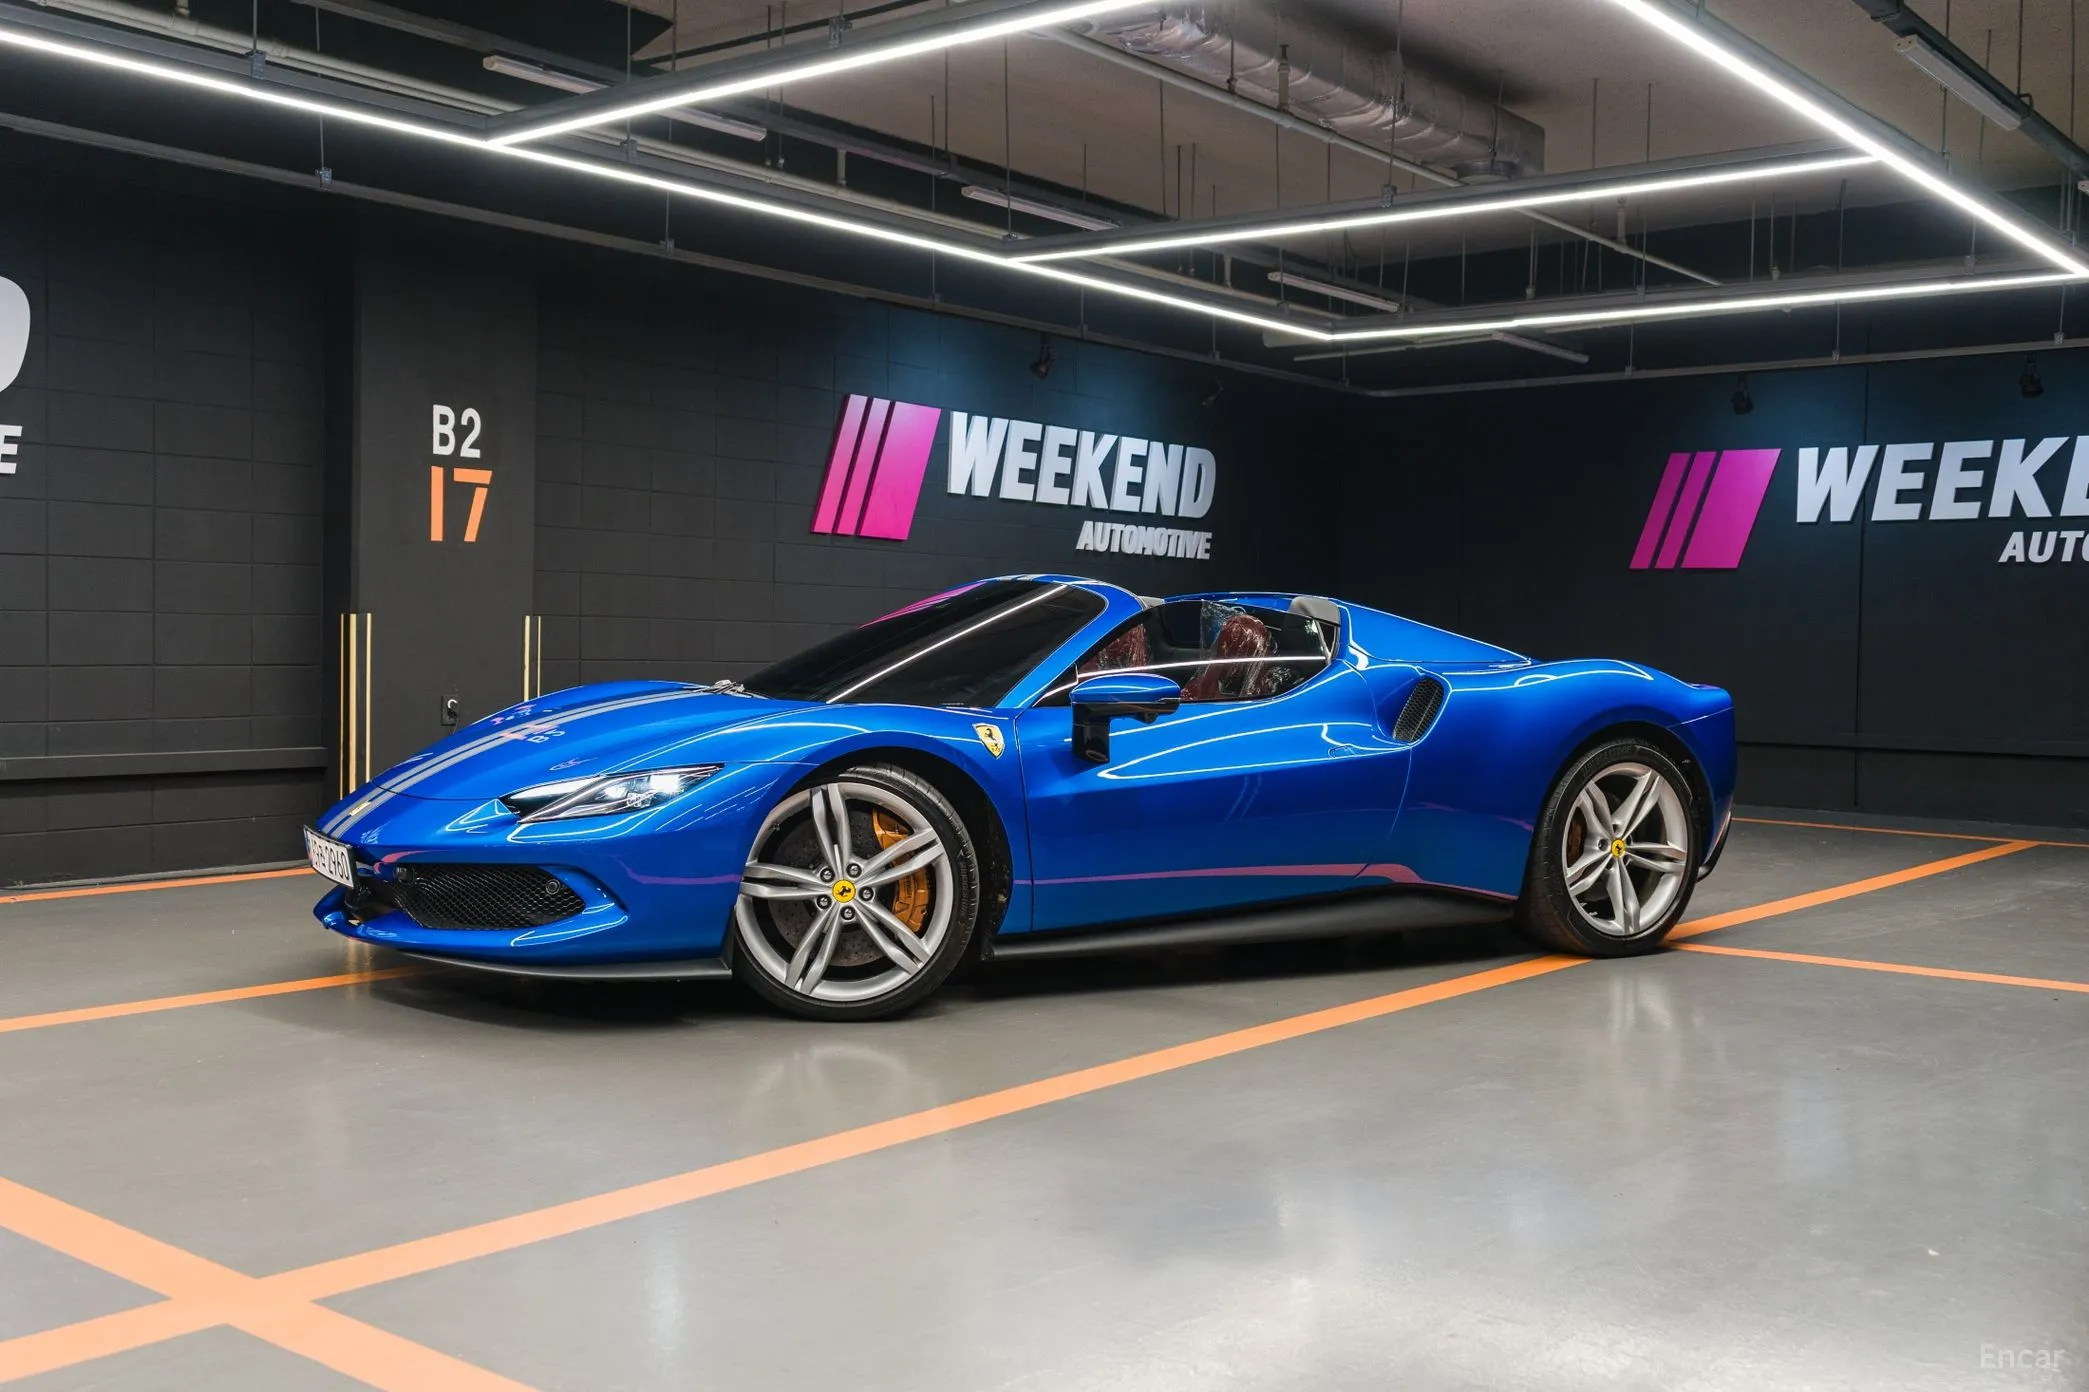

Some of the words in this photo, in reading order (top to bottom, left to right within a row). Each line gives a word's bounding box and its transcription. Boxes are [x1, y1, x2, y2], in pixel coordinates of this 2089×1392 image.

[432, 404, 482, 458] B2
[946, 410, 1217, 519] WEEKEND
[430, 465, 493, 542] 17
[1075, 521, 1213, 560] AUTOMOTIVE
